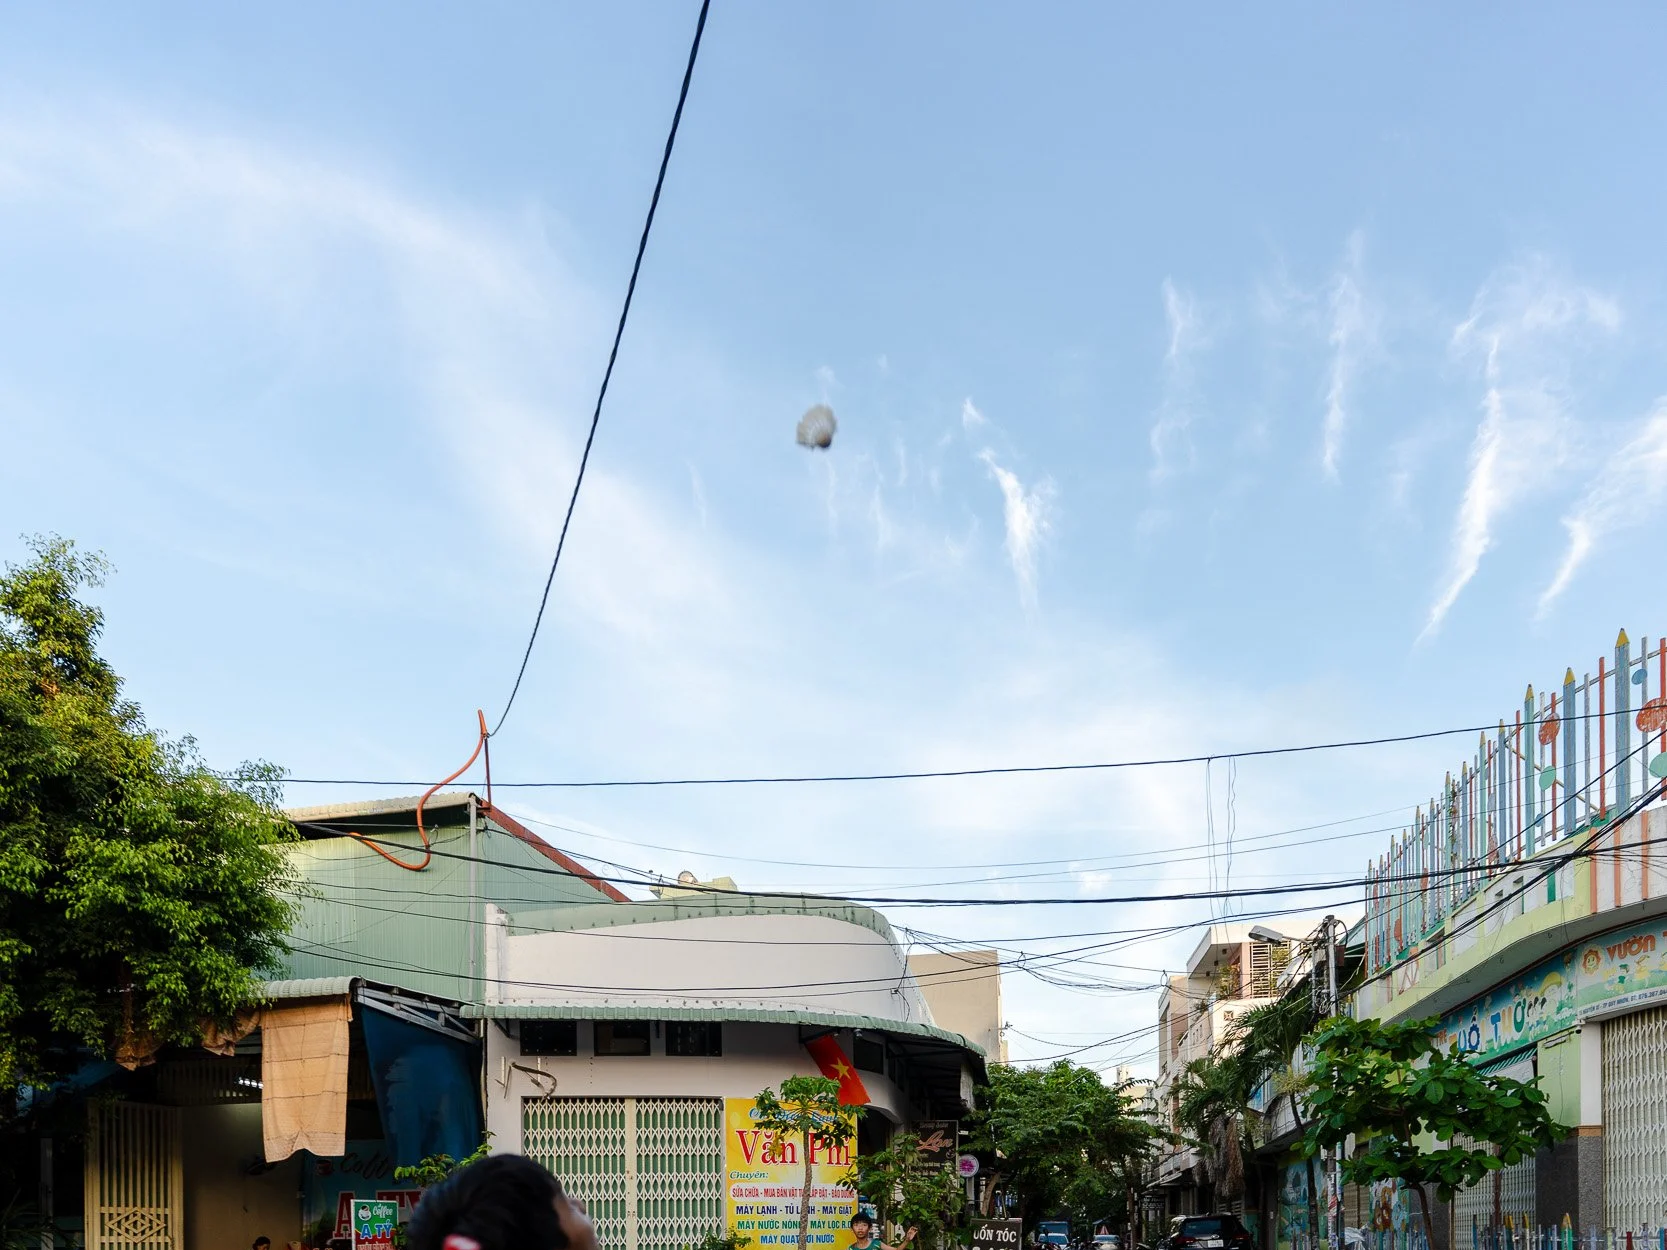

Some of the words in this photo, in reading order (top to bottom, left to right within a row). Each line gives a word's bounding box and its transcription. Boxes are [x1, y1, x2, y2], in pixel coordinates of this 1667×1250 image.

[736, 1130, 798, 1165] Văn
[763, 1188, 776, 1198] MUA
[776, 1186, 788, 1198] BÁN
[736, 1204, 754, 1214] MÁY
[756, 1205, 777, 1217] LẠNH
[796, 1206, 815, 1215] LNH
[822, 1204, 837, 1215] MÁY
[737, 1218, 755, 1229] MÁY
[810, 1218, 825, 1229] MÁY
[360, 1223, 373, 1240] A
[996, 1228, 1017, 1242] TÓC
[760, 1233, 777, 1244] MÁY
